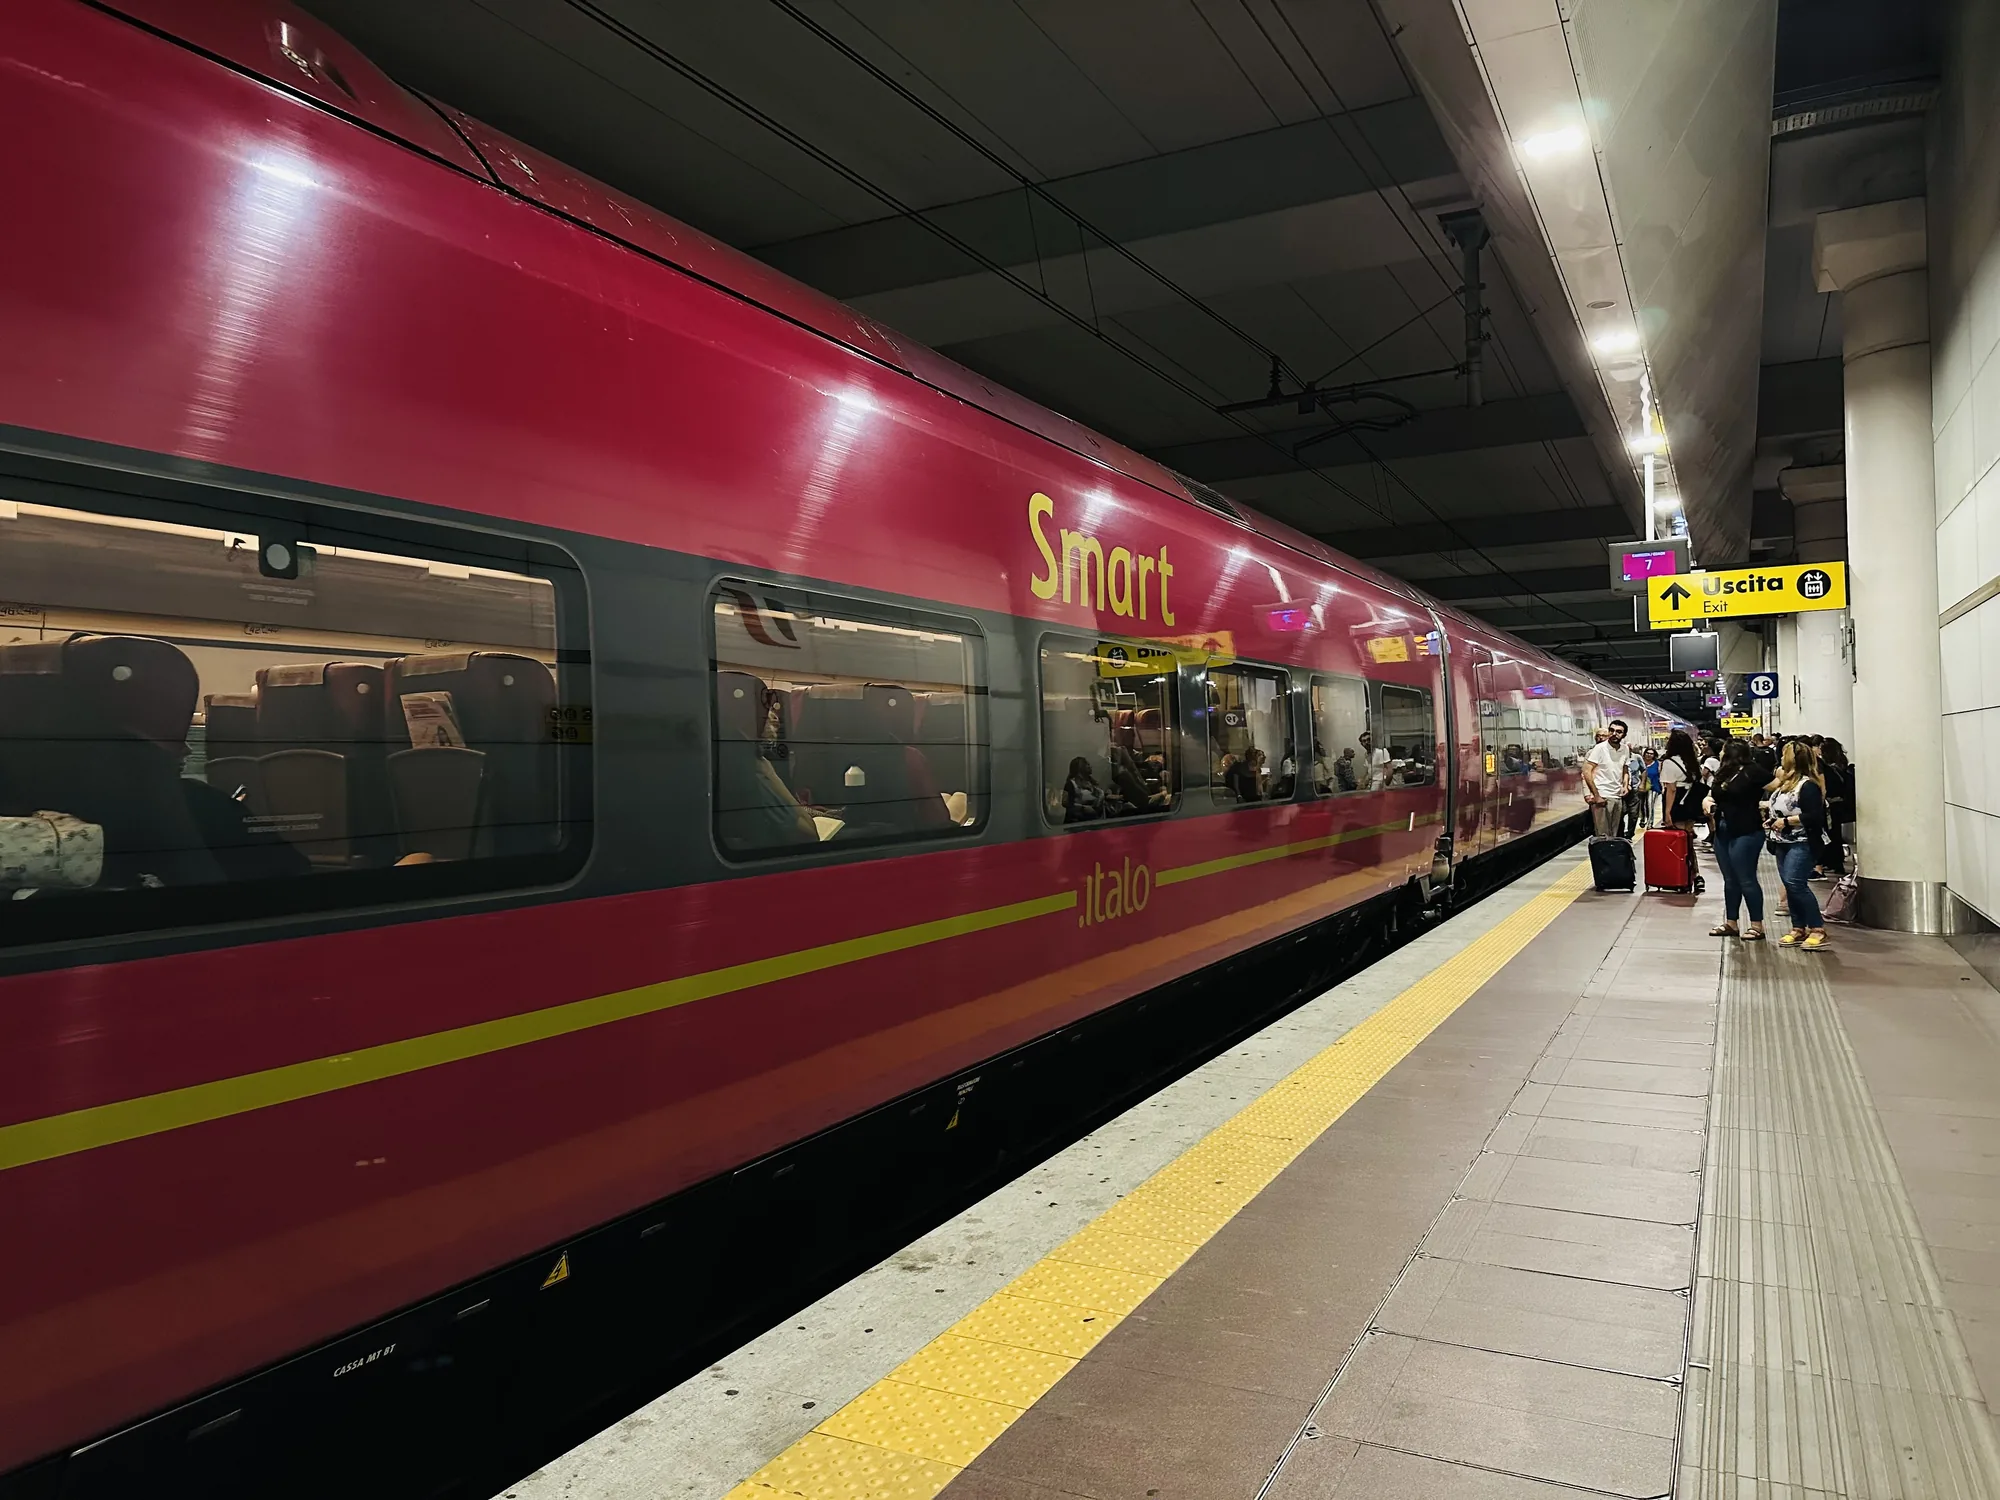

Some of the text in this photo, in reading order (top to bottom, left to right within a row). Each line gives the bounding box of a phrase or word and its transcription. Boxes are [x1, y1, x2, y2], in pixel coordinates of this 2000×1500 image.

[1028, 492, 1175, 627] Smart
[1645, 559, 1653, 570] 7
[1703, 574, 1784, 595] Uscita
[1703, 600, 1728, 613] Exit
[1754, 680, 1771, 691] 18
[333, 1343, 396, 1377] CASSA MT BT
